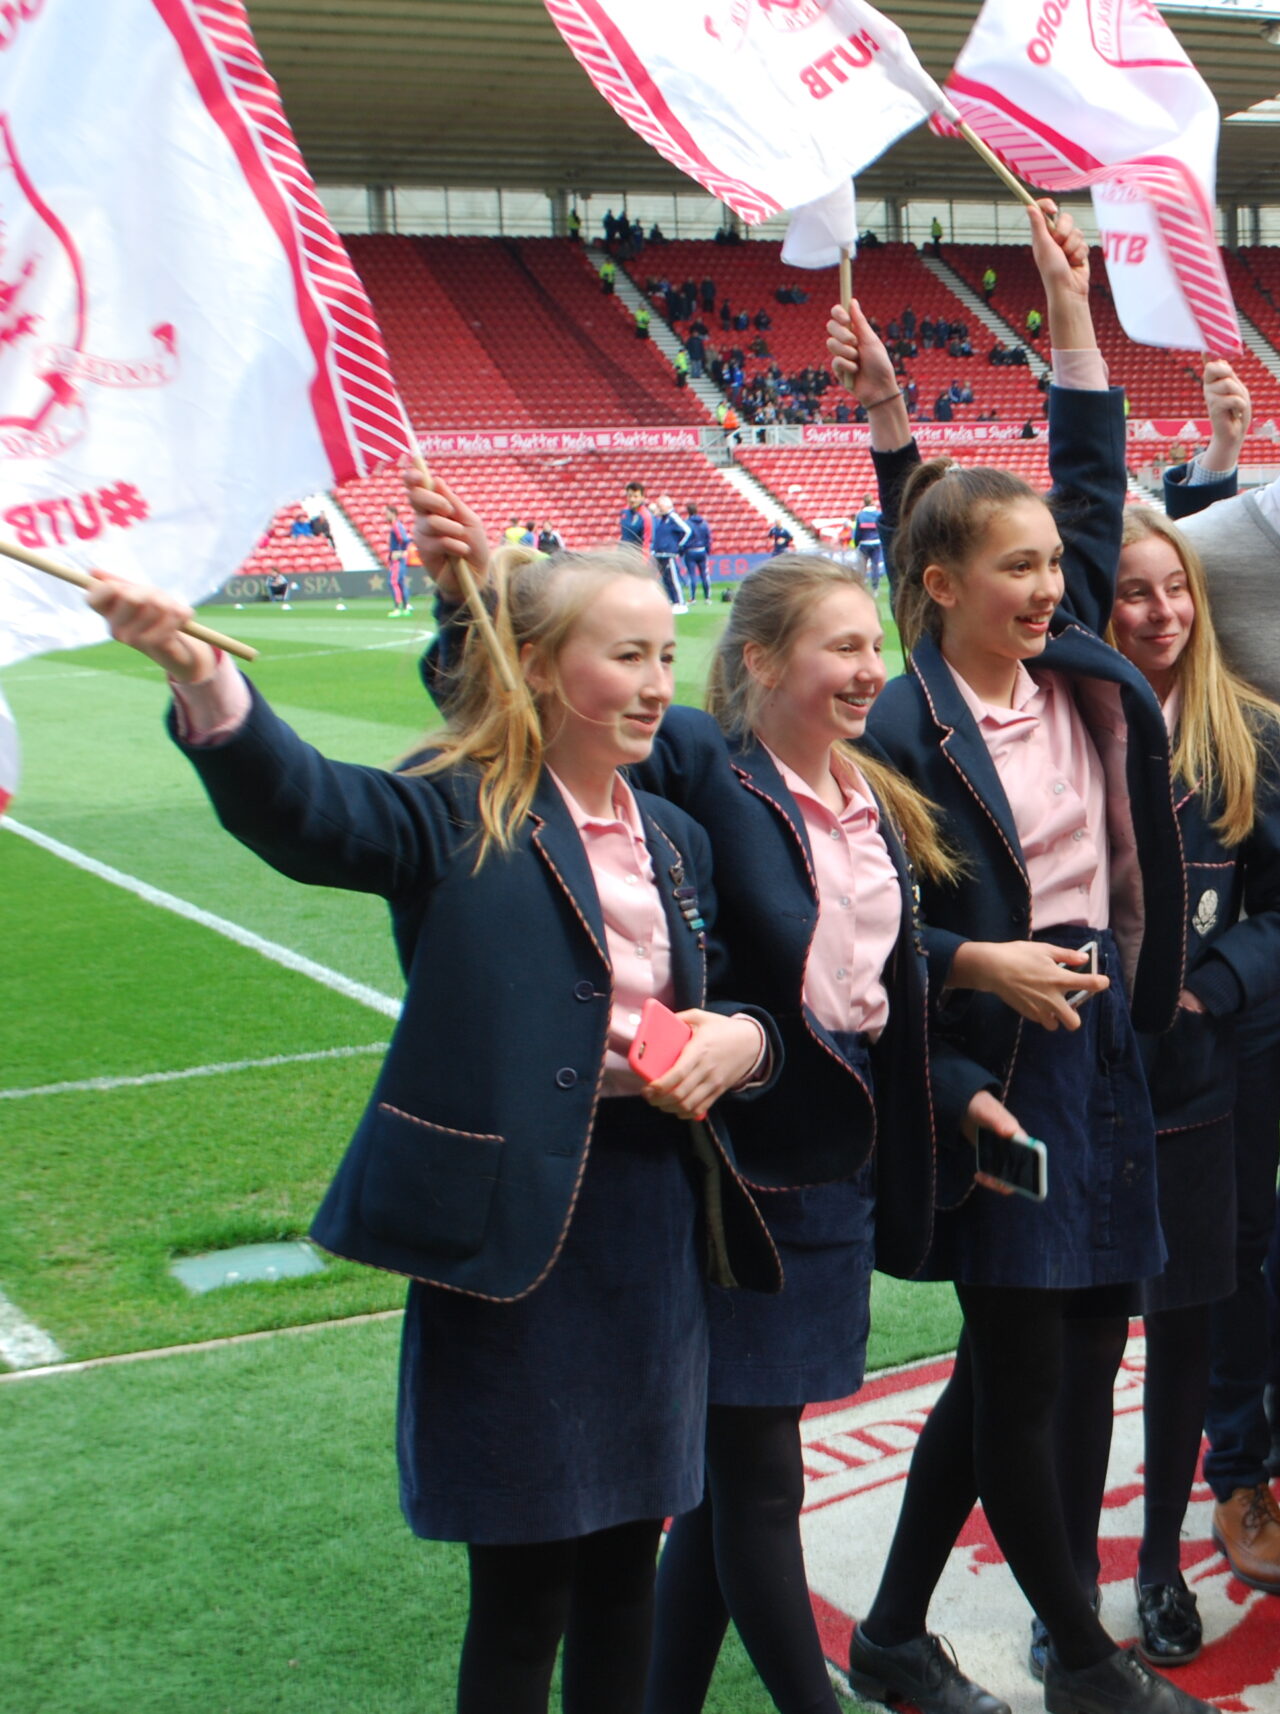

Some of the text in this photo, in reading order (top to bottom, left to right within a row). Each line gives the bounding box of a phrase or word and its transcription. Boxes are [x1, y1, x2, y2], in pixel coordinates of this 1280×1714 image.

[510, 432, 595, 449] Shutter Media
[612, 430, 694, 447] Shutter Media
[806, 427, 850, 443] Shutter
[304, 576, 342, 594] SPA
